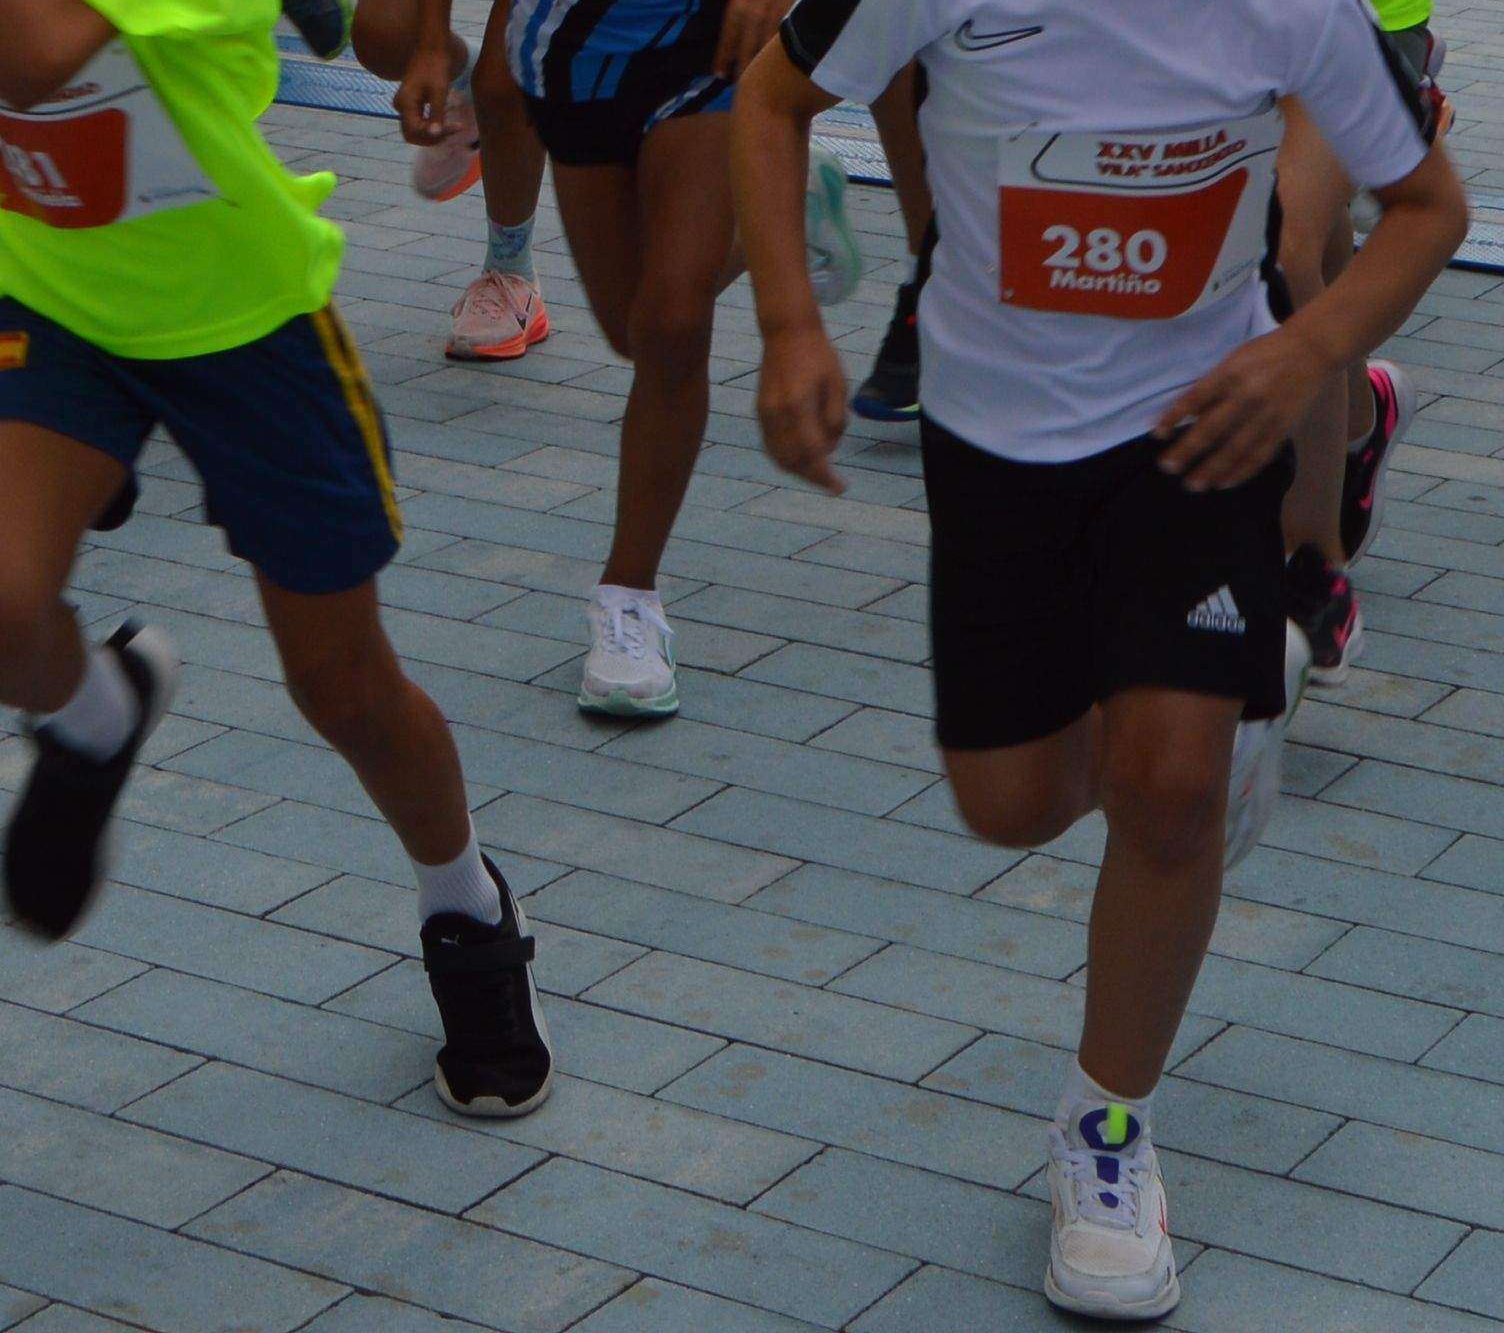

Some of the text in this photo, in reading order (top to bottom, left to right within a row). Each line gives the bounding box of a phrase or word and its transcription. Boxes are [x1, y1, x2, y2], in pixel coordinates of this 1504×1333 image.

[1096, 129, 1228, 161] XXV MILLA
[1042, 224, 1168, 275] 280
[1049, 268, 1162, 295] Martiño
